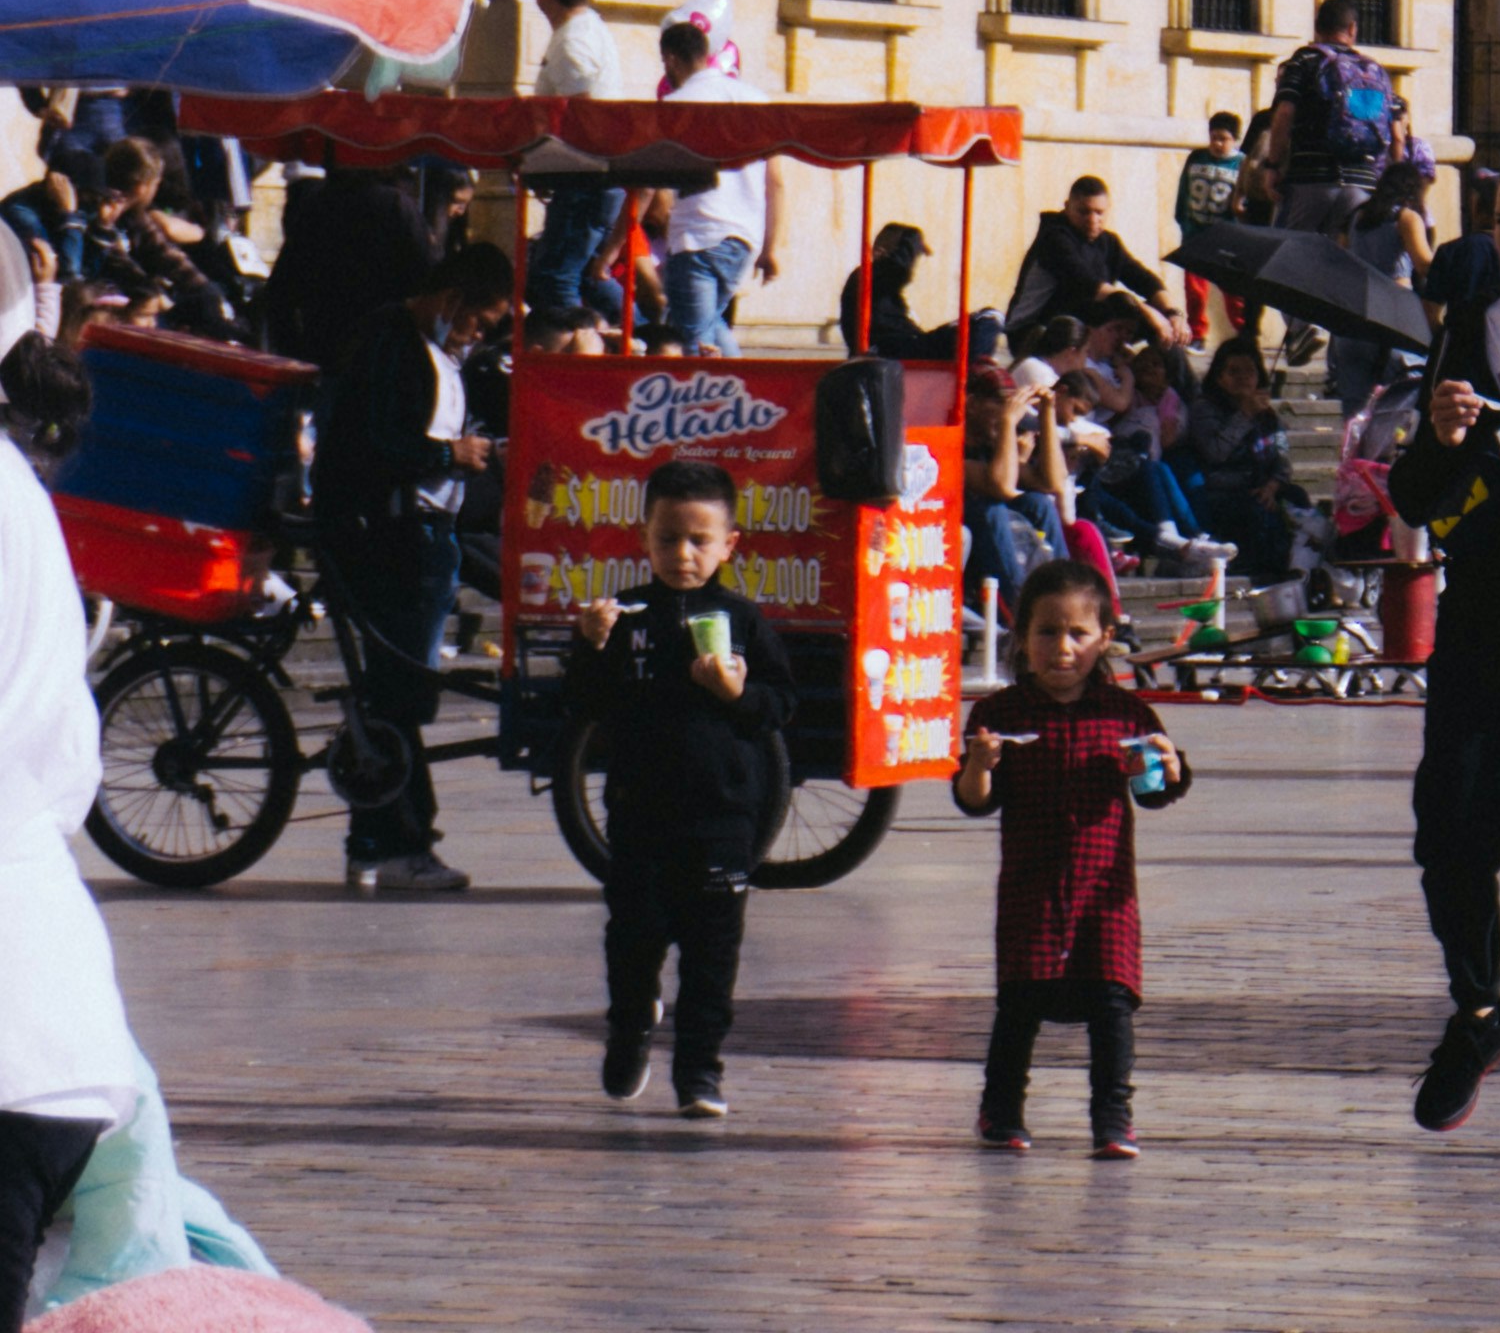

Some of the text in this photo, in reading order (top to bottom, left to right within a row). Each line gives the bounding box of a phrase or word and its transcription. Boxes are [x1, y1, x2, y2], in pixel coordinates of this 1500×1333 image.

[634, 374, 738, 412] Dulce
[589, 397, 781, 454] Helado
[722, 446, 742, 459] de
